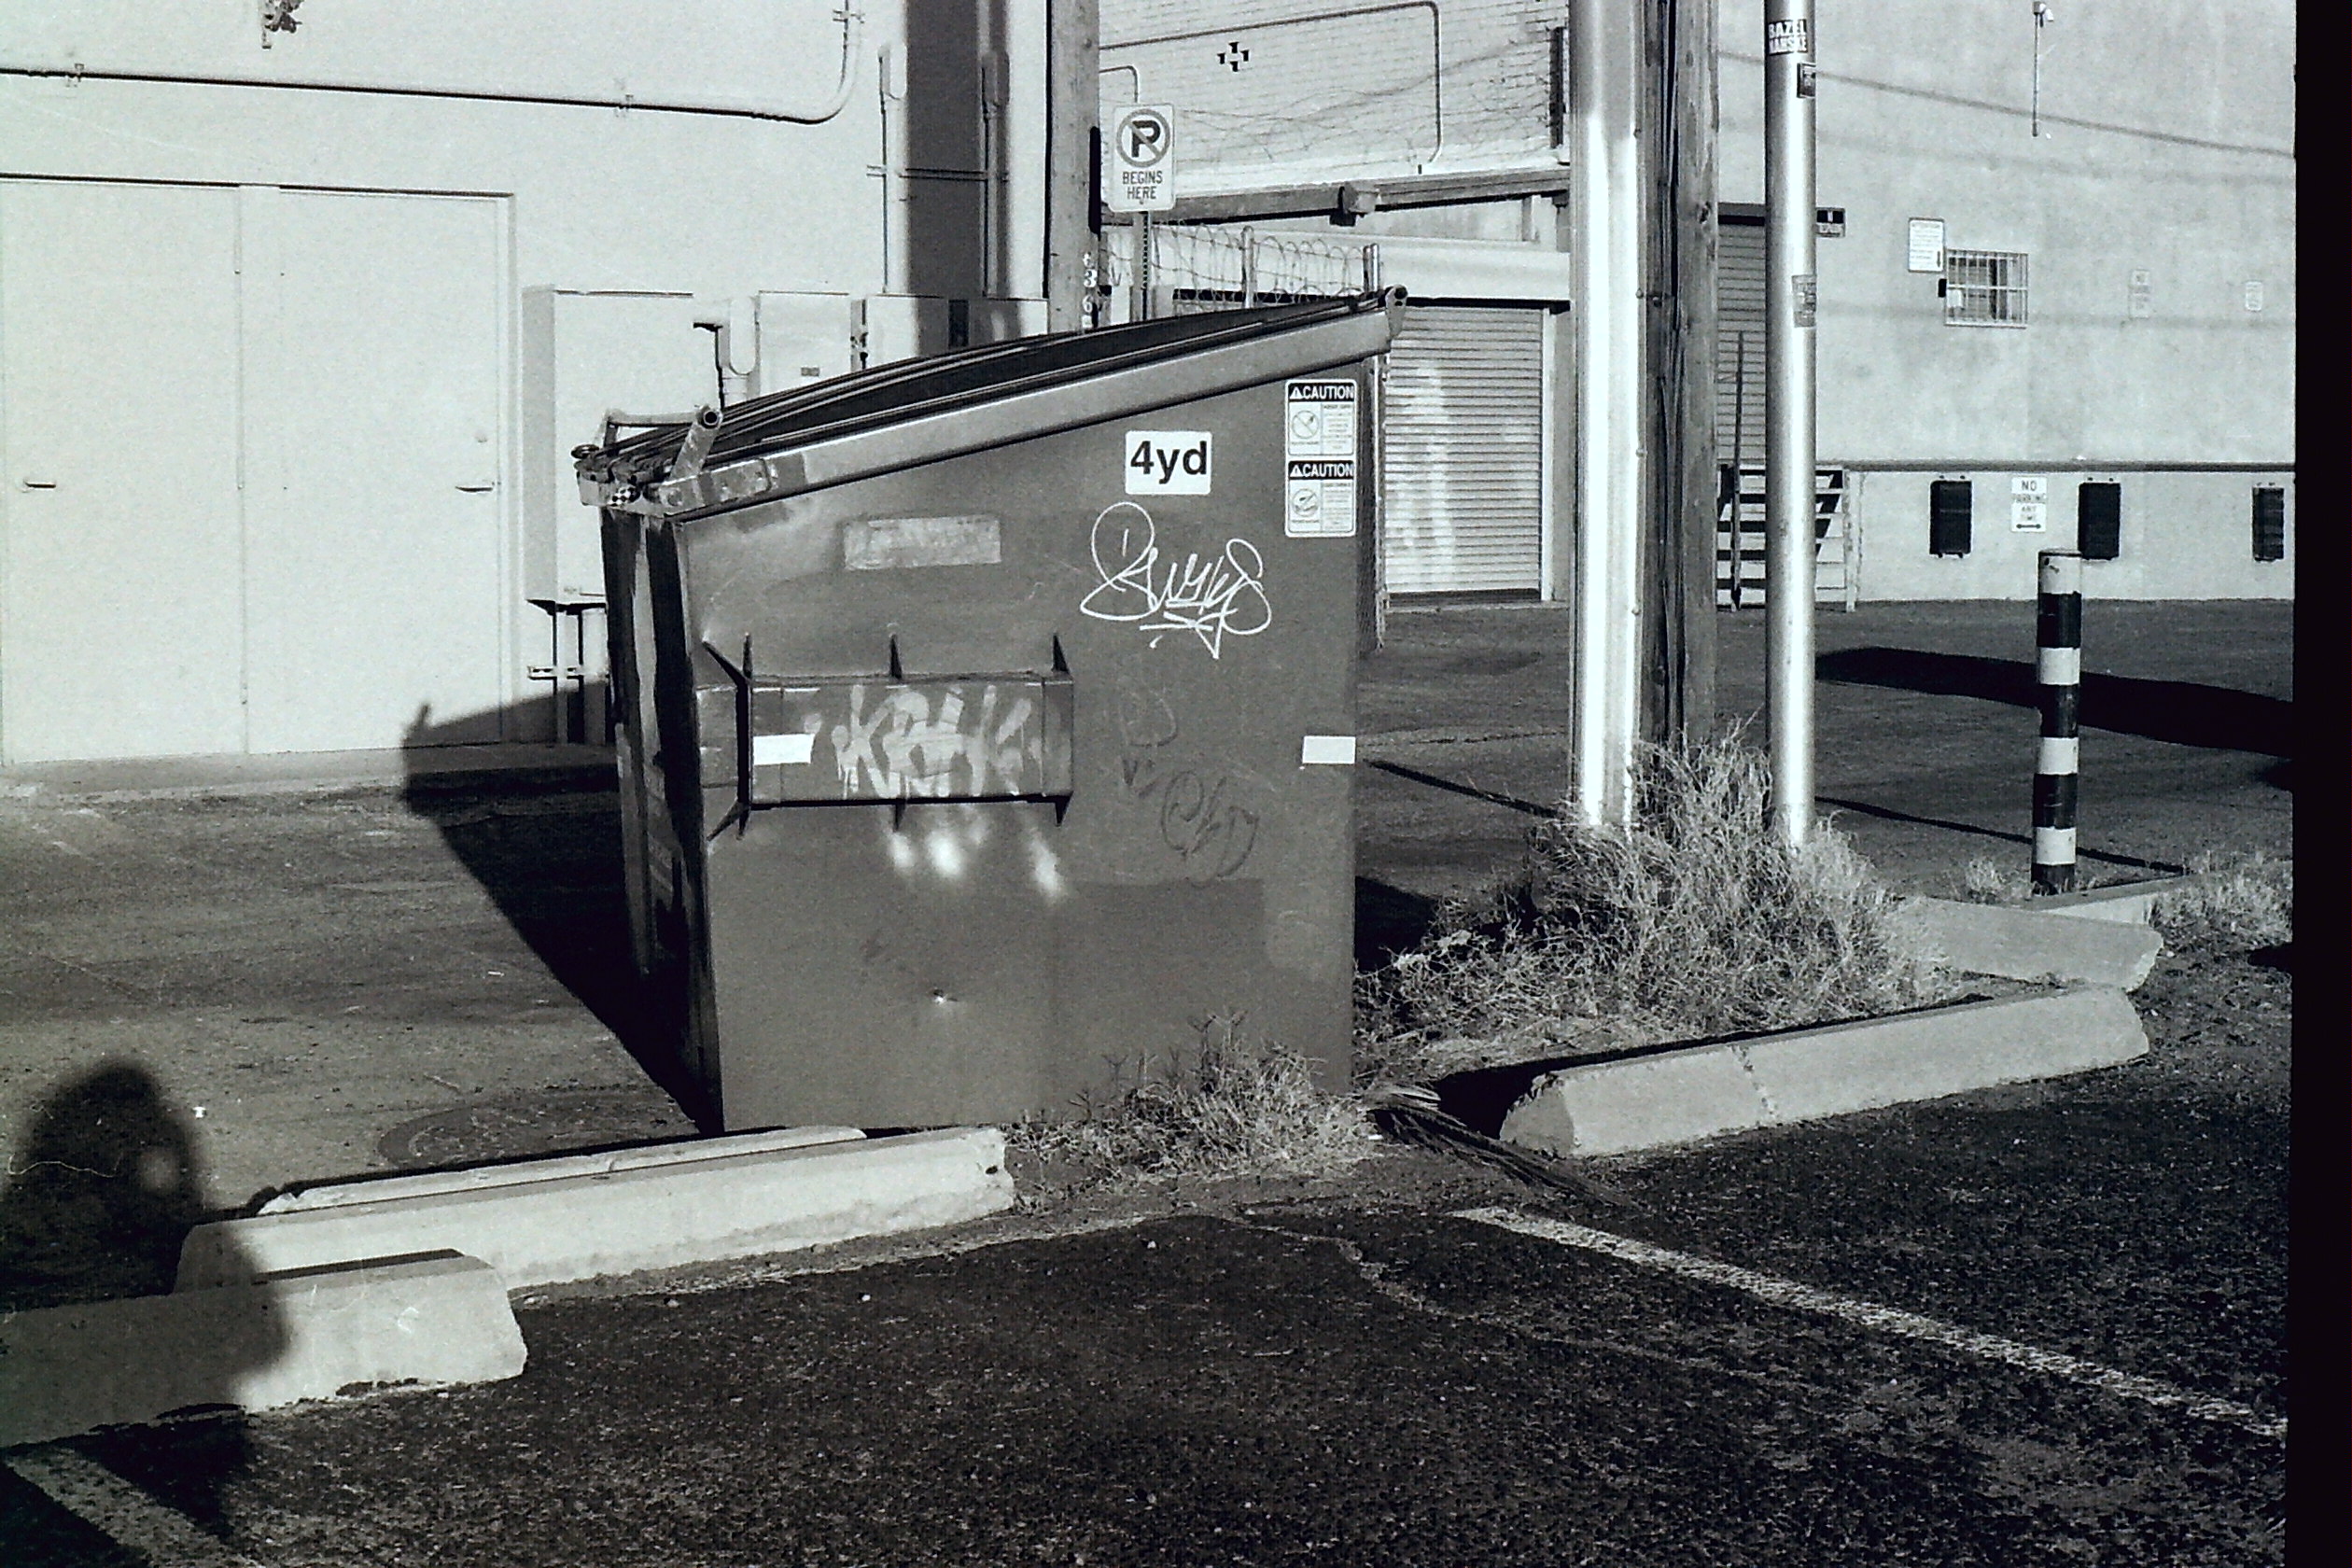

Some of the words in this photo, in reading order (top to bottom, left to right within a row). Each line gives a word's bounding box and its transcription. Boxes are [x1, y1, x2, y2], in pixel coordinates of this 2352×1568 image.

[1122, 170, 1163, 185] BEGINS
[1127, 186, 1157, 200] HERE
[1302, 385, 1354, 399] CAUTION
[1129, 440, 1208, 484] 4yd
[1302, 463, 1354, 478] CAUTION
[2021, 480, 2037, 492] NO
